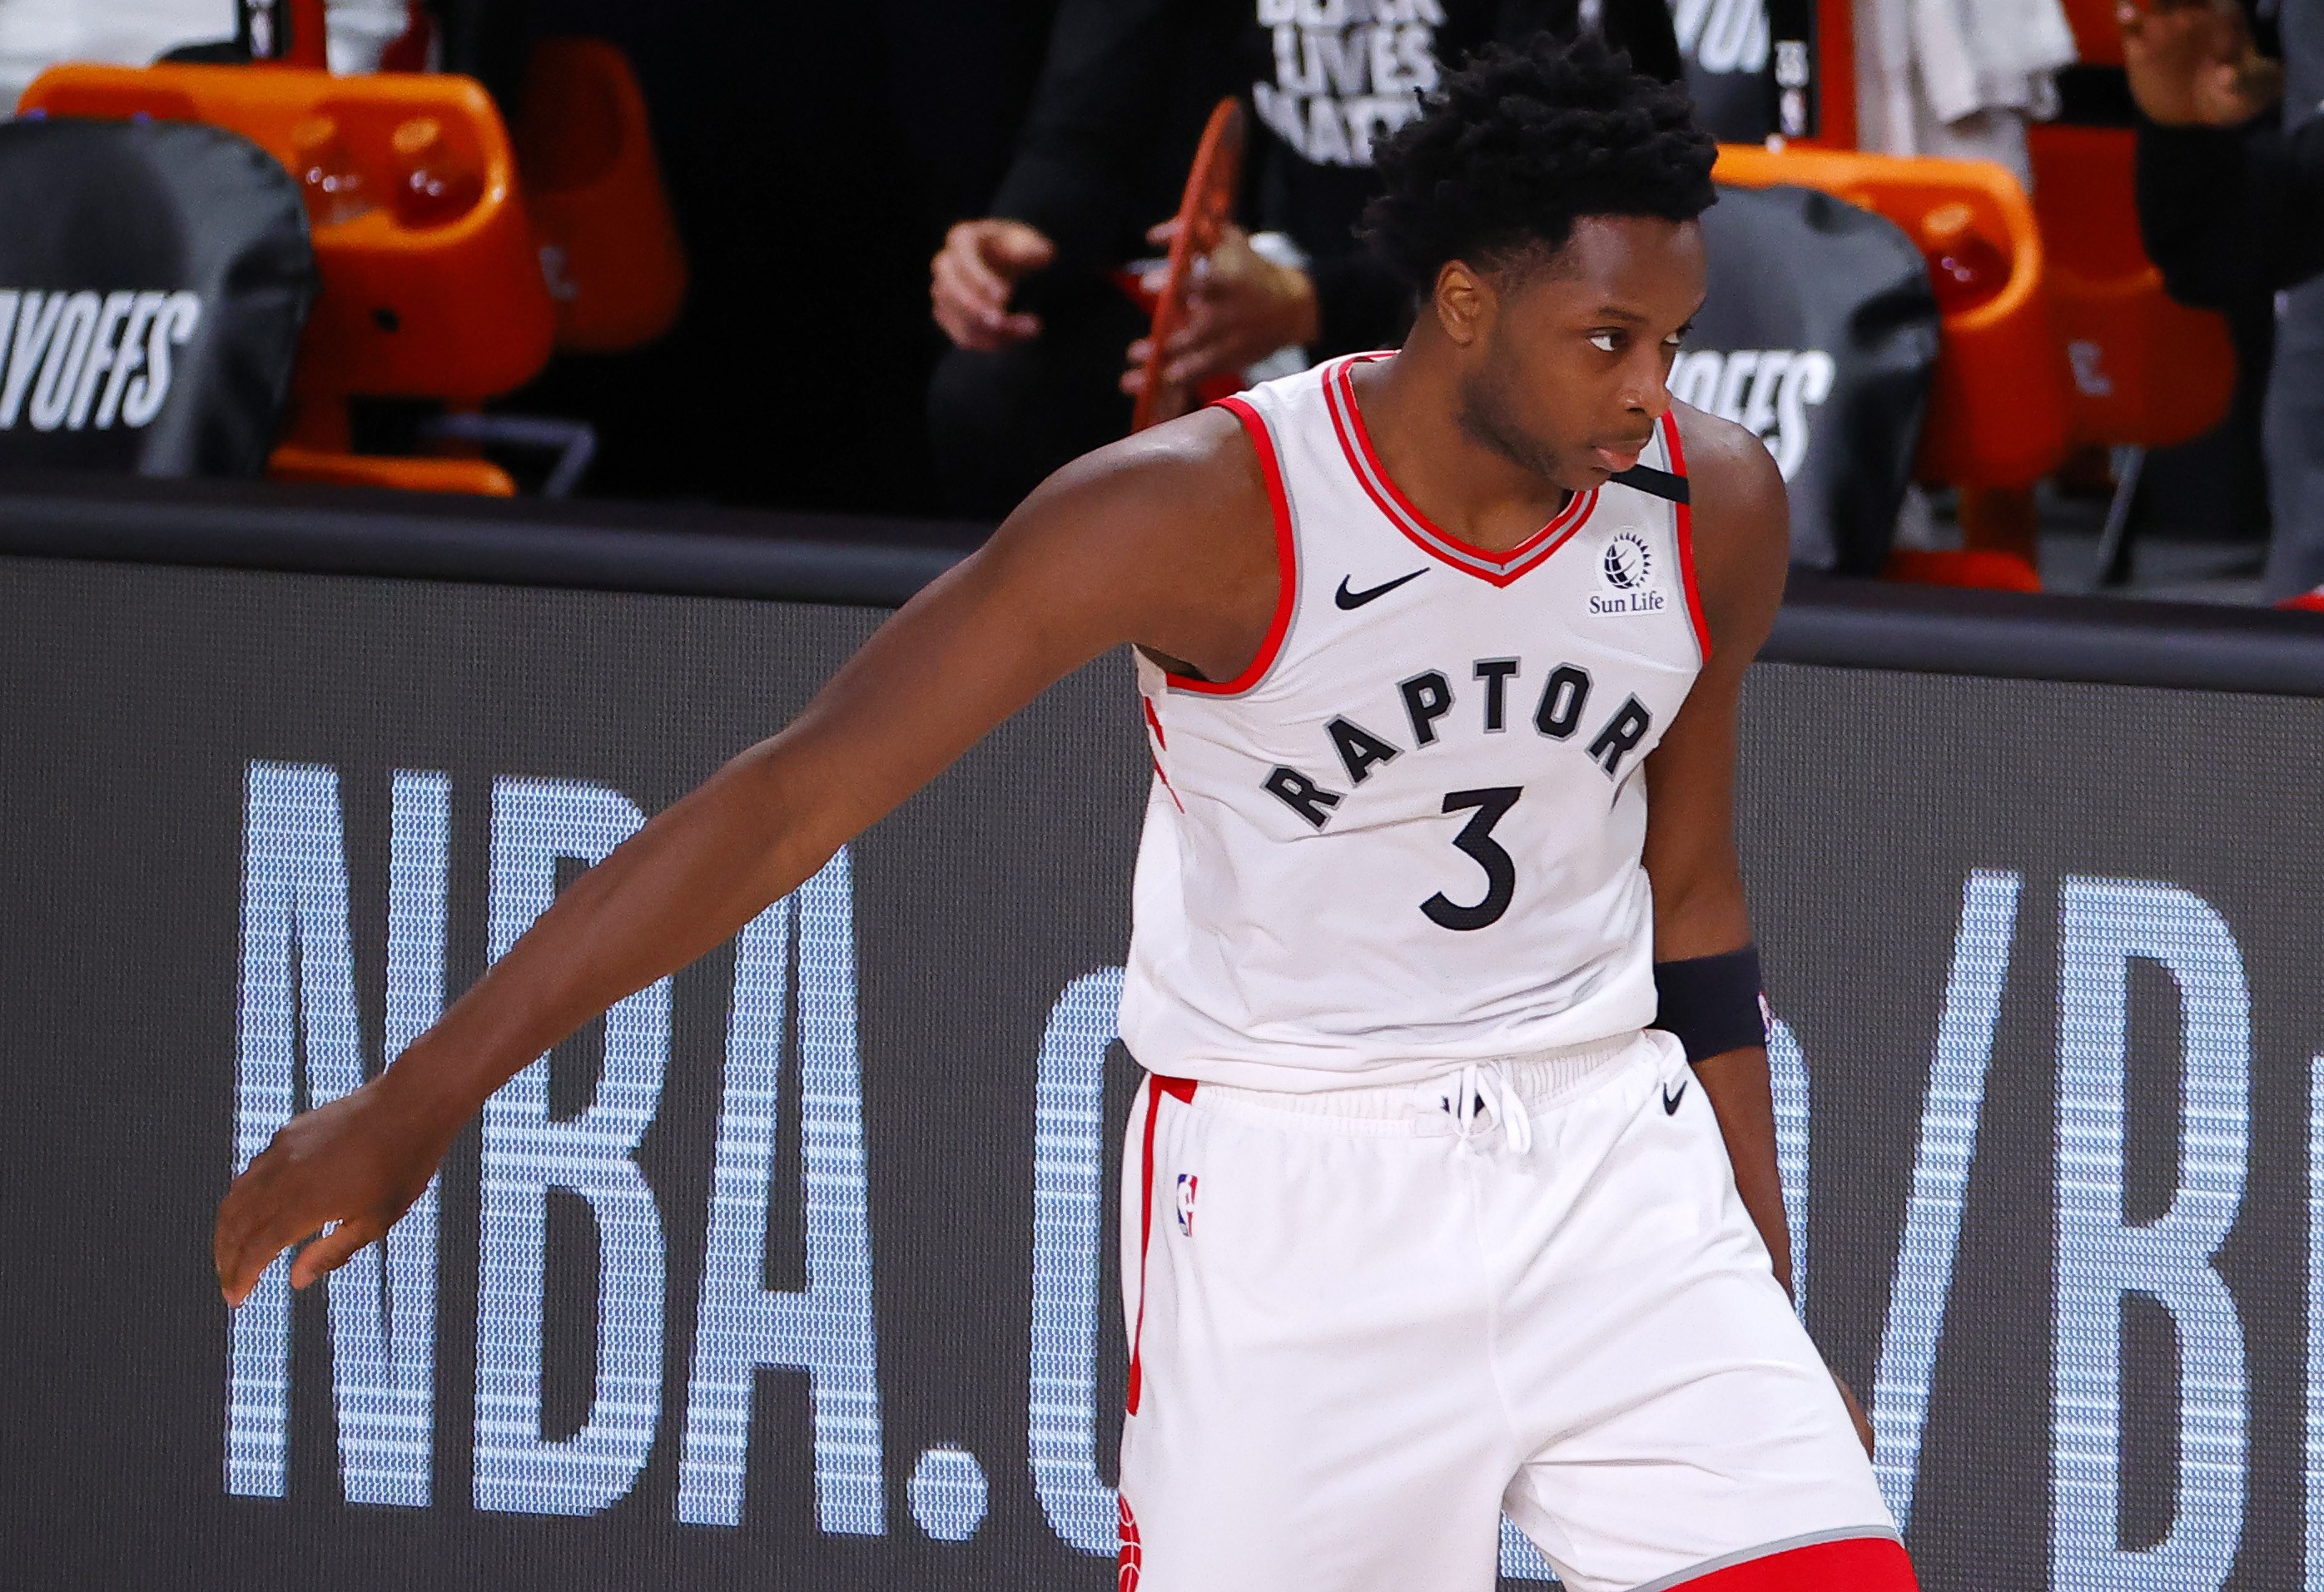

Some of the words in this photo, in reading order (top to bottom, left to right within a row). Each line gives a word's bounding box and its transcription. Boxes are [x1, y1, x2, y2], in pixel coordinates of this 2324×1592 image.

[1273, 22, 1440, 94] LIVES
[0, 289, 201, 430] YOFFS
[1589, 596, 1626, 614] Sun
[1631, 590, 1664, 611] Life
[1420, 786, 1523, 931] 3
